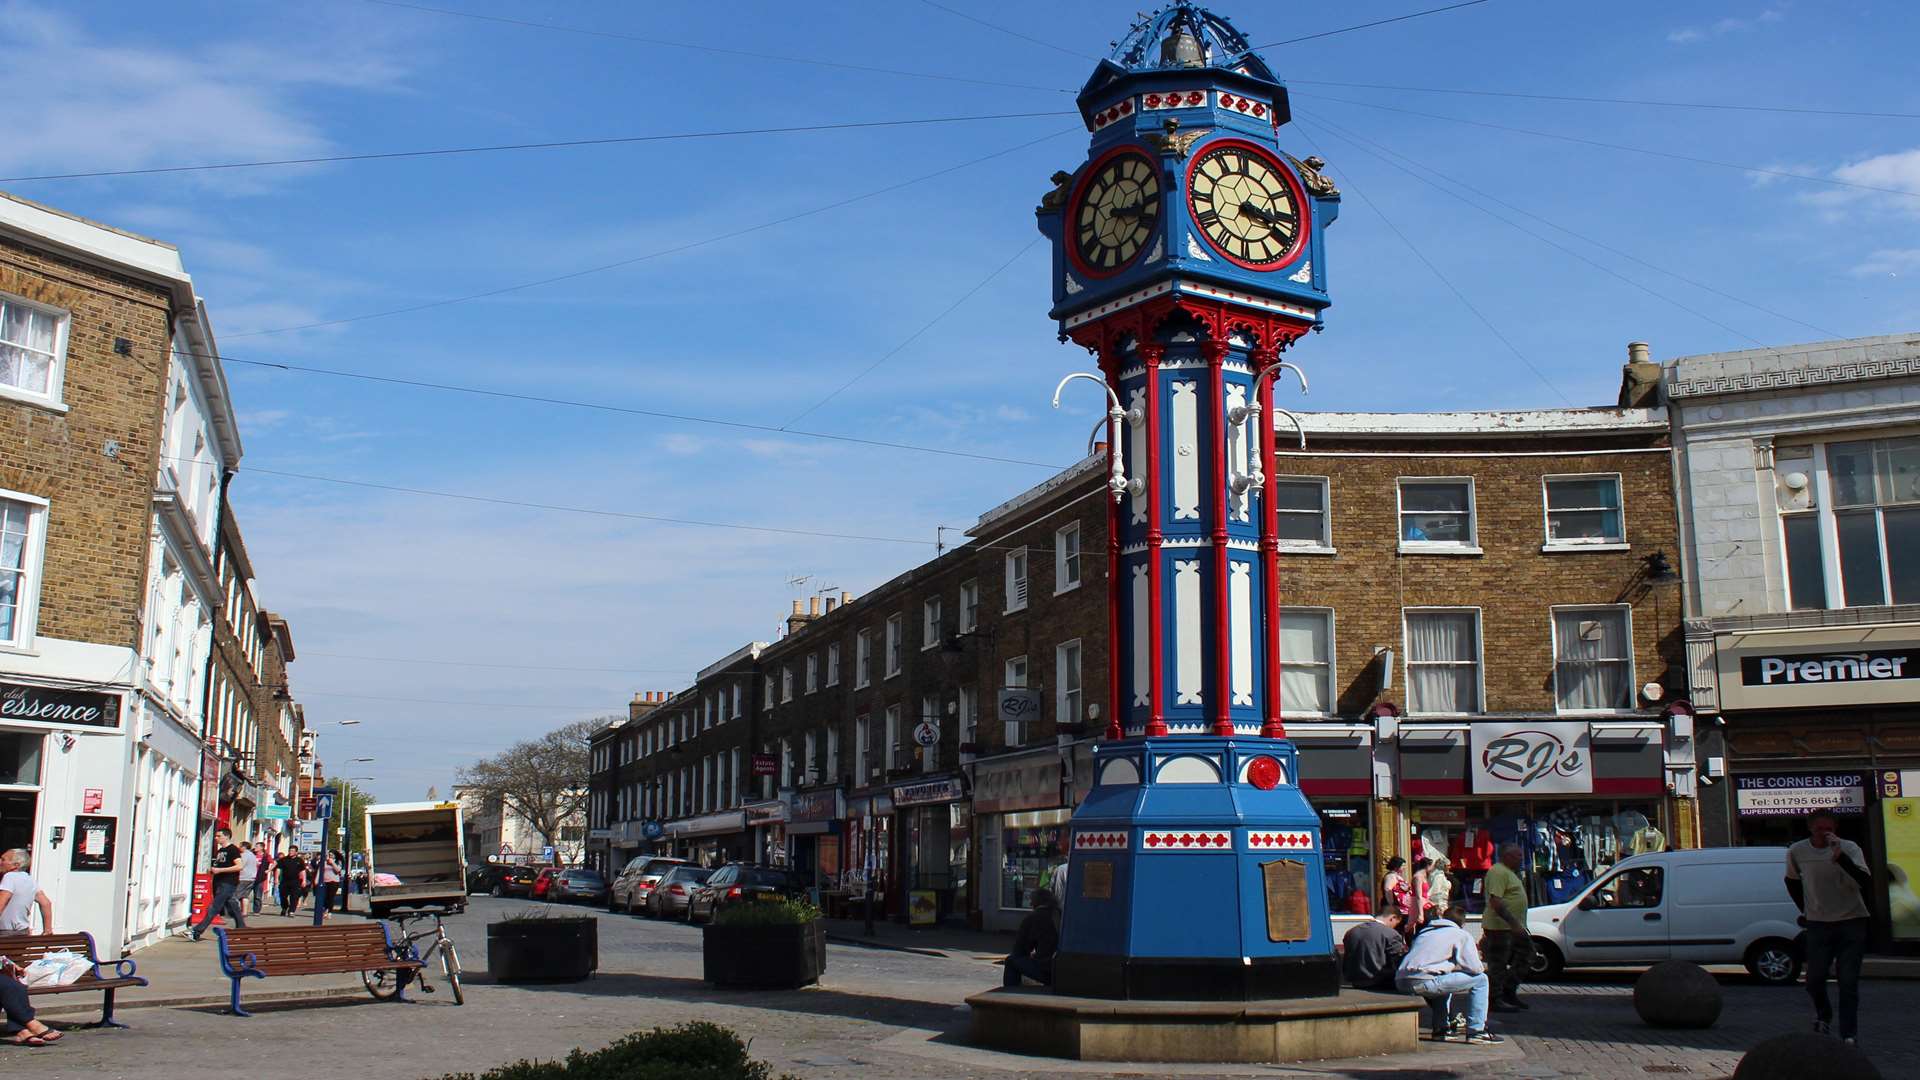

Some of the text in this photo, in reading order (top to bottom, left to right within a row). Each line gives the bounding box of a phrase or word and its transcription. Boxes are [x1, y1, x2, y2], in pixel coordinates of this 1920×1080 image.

[1761, 653, 1908, 684] Premier
[1, 698, 100, 721] essence
[1739, 775, 1862, 789] THE CORNER SHOP
[1751, 796, 1853, 807] Tel: 01795 666419
[1740, 808, 1801, 816] SUPERMARKET
